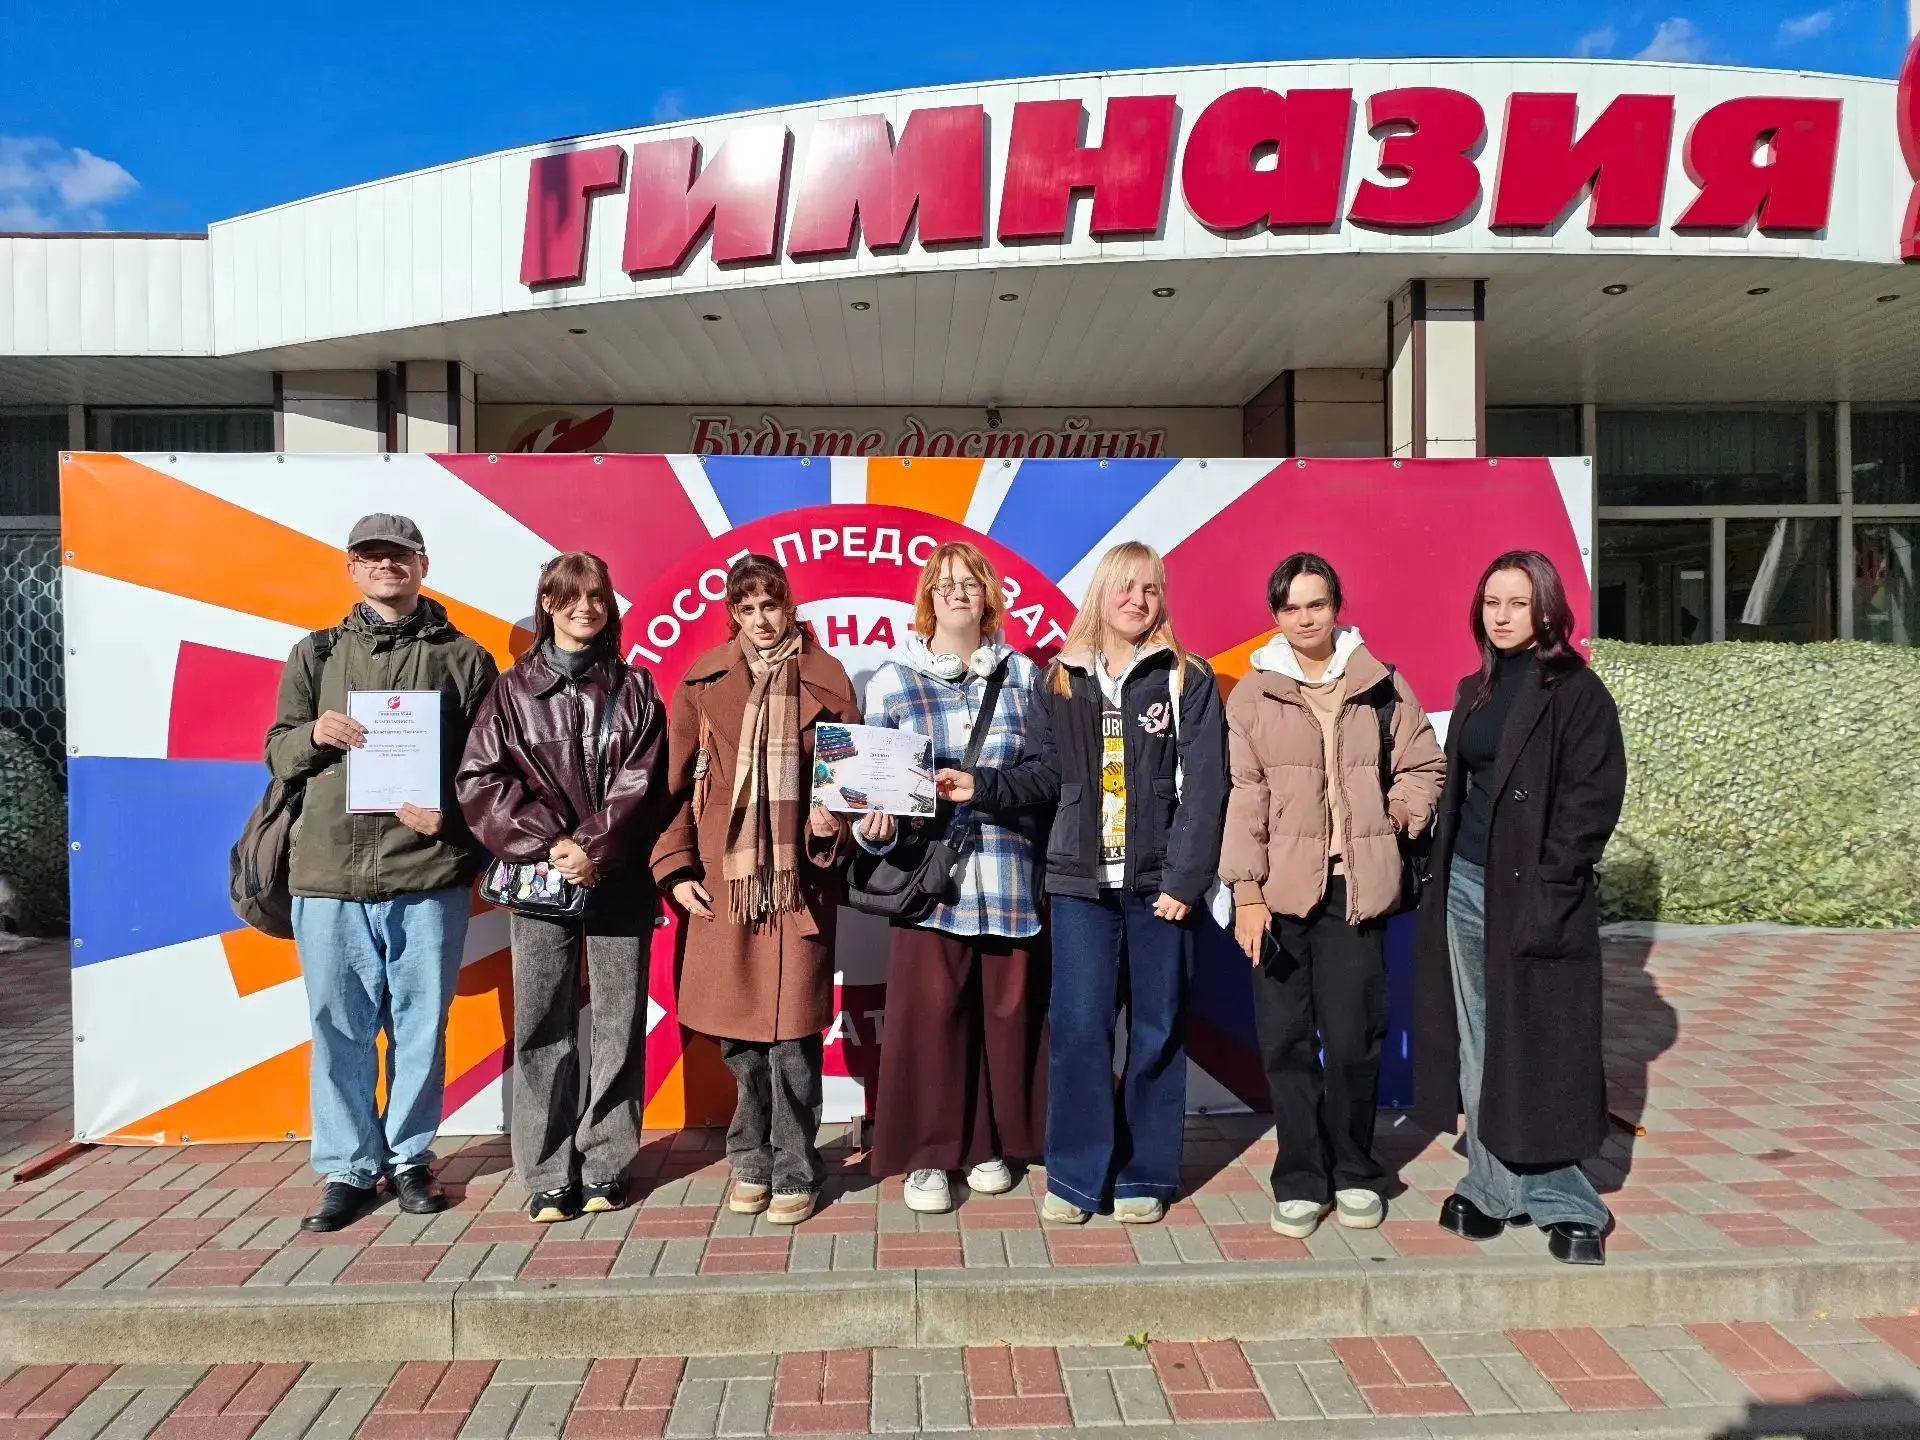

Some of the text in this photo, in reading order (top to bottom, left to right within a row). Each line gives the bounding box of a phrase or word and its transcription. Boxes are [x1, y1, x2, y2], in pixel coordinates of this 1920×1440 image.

[691, 416, 1163, 457] Будьте достойны
[626, 548, 750, 665] ПОСО
[808, 614, 916, 649] НА
[823, 1010, 885, 1046] АТ
